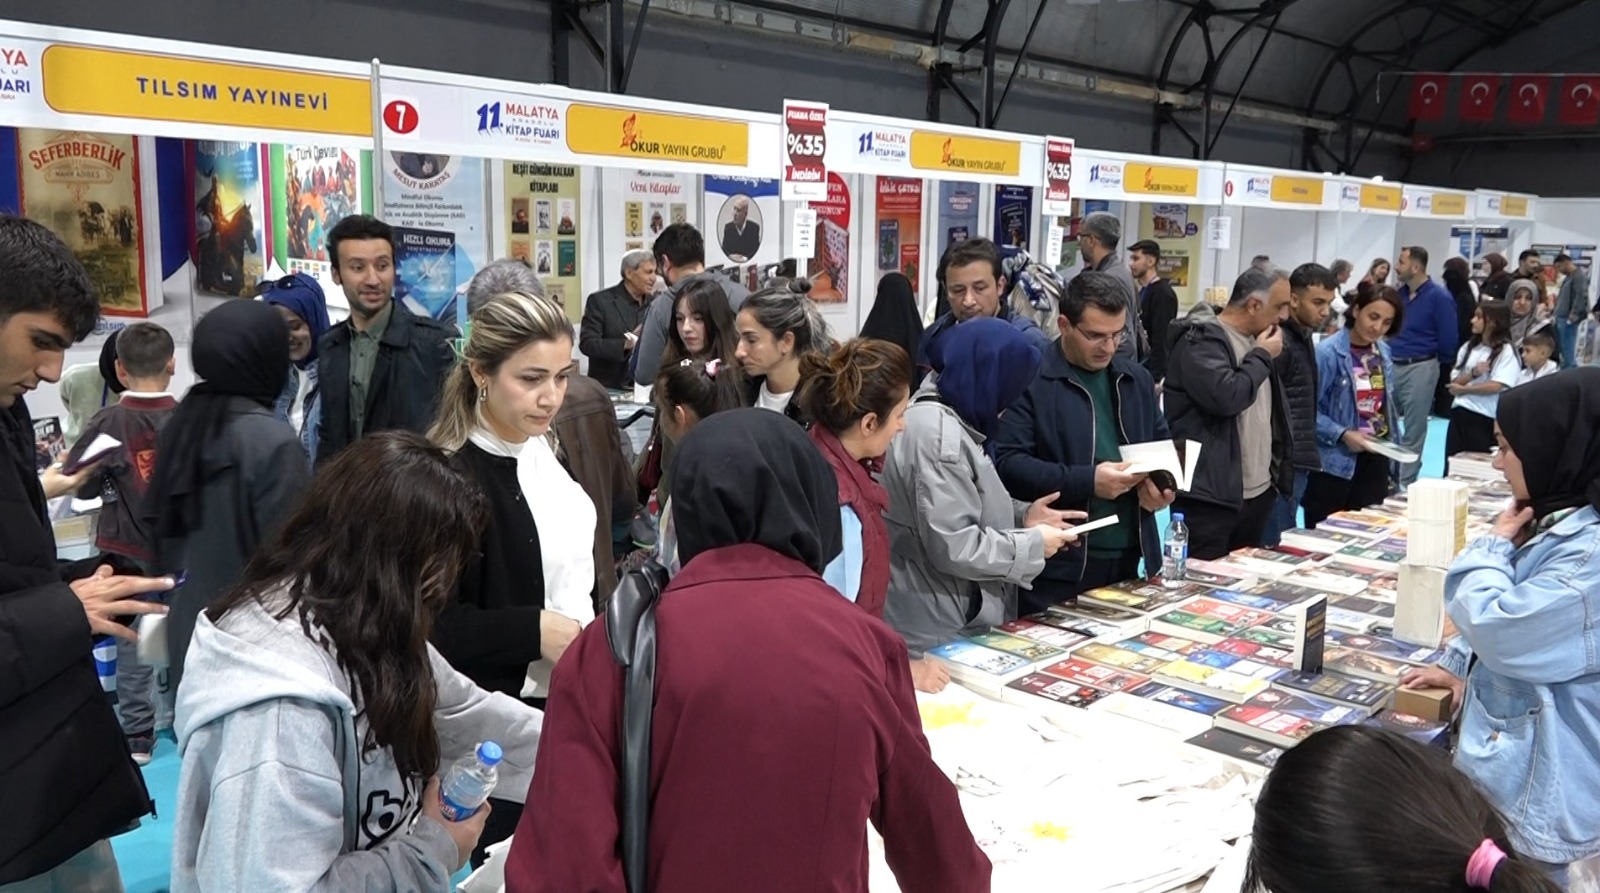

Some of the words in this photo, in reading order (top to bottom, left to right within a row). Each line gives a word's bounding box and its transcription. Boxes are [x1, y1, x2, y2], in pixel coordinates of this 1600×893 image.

[136, 77, 217, 100] TILSIM
[228, 86, 328, 110] YAYINEVİ
[396, 104, 407, 130] 7
[477, 101, 504, 132] 11.
[505, 103, 559, 120] MALATYA
[787, 110, 808, 121] FUARA
[809, 110, 825, 121] ÖZEL
[505, 124, 532, 135] KİTAP
[534, 127, 560, 139] FUARI
[875, 131, 907, 144] MALATYA
[630, 141, 660, 154] OKUR
[662, 144, 689, 156] YAYIN
[787, 133, 824, 156] %35
[29, 141, 126, 170] SEFERBERLİK
[947, 157, 966, 168] OKUR
[966, 159, 983, 170] YAYIN
[1047, 162, 1070, 180] %35
[393, 168, 417, 189] MESUT
[419, 171, 451, 189] KARATAŞ
[552, 165, 575, 178] KALKAN
[791, 167, 821, 181] İNDİRİM
[529, 179, 559, 193] KİTAPLARI
[649, 182, 682, 196] Kitaplar
[403, 234, 424, 245] HIZLI
[426, 235, 452, 247] OKUMA
